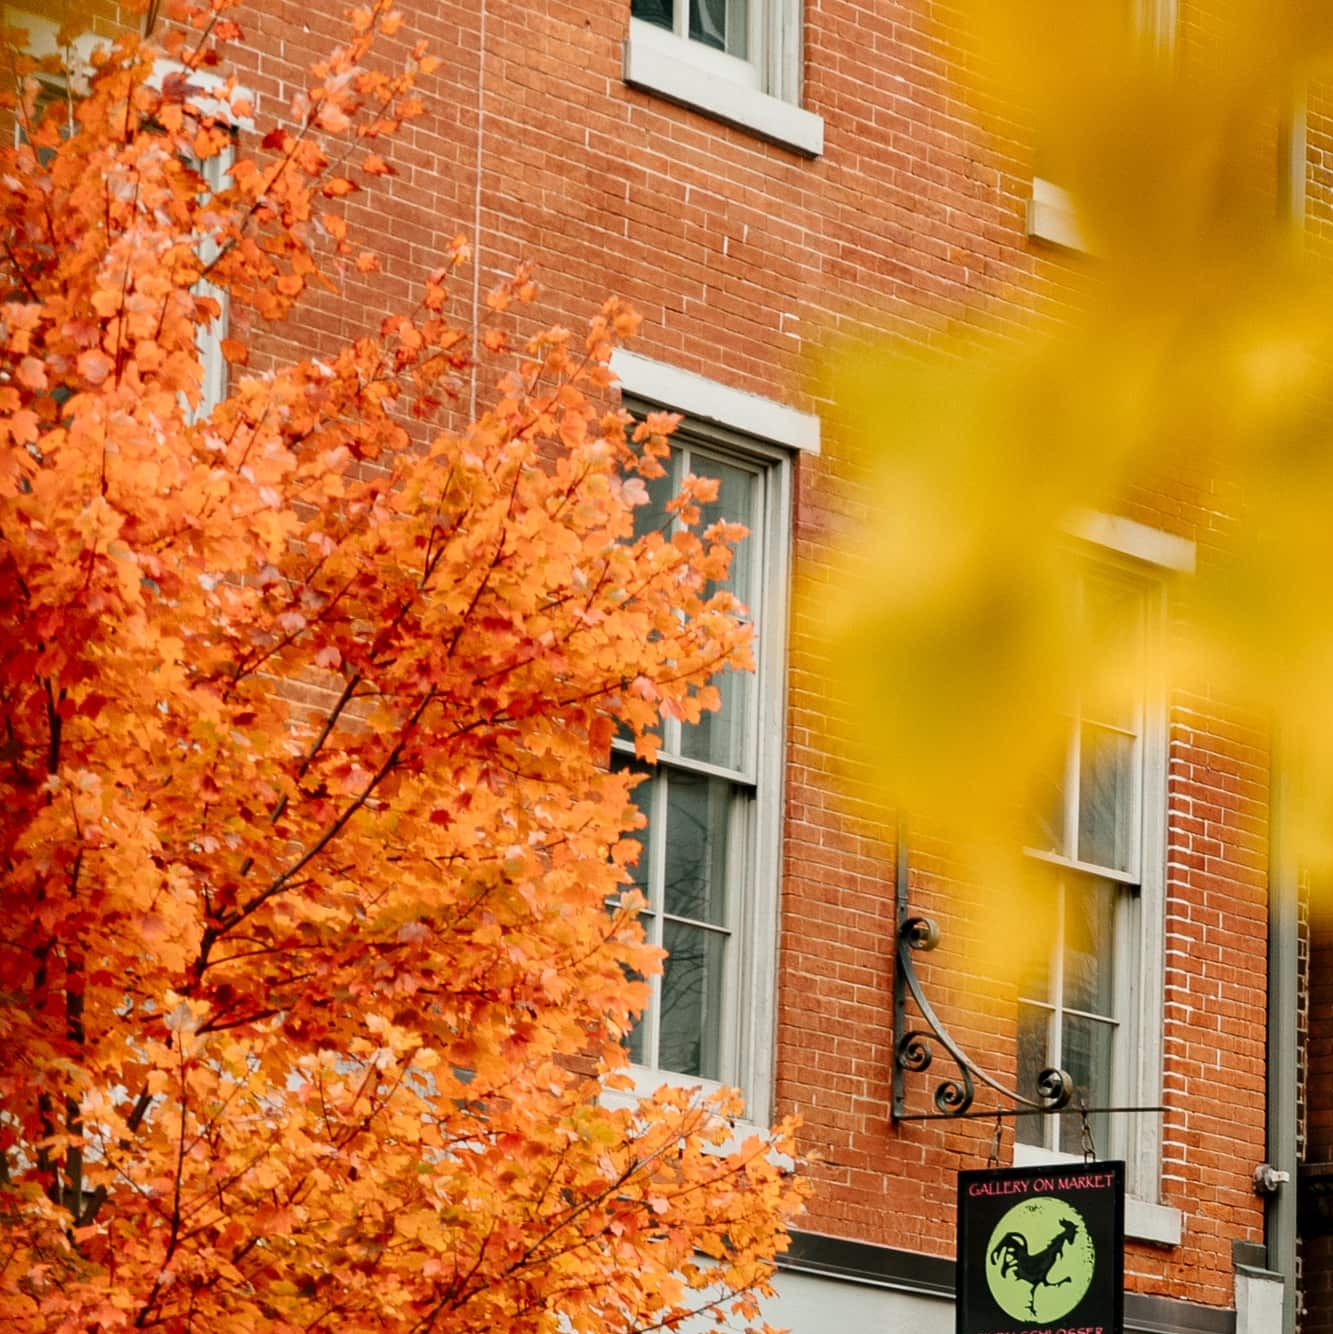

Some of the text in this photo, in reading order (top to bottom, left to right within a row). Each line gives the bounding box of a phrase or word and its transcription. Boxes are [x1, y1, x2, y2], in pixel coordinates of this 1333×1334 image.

[968, 1174, 1114, 1197] GALLERY ON MARKET
